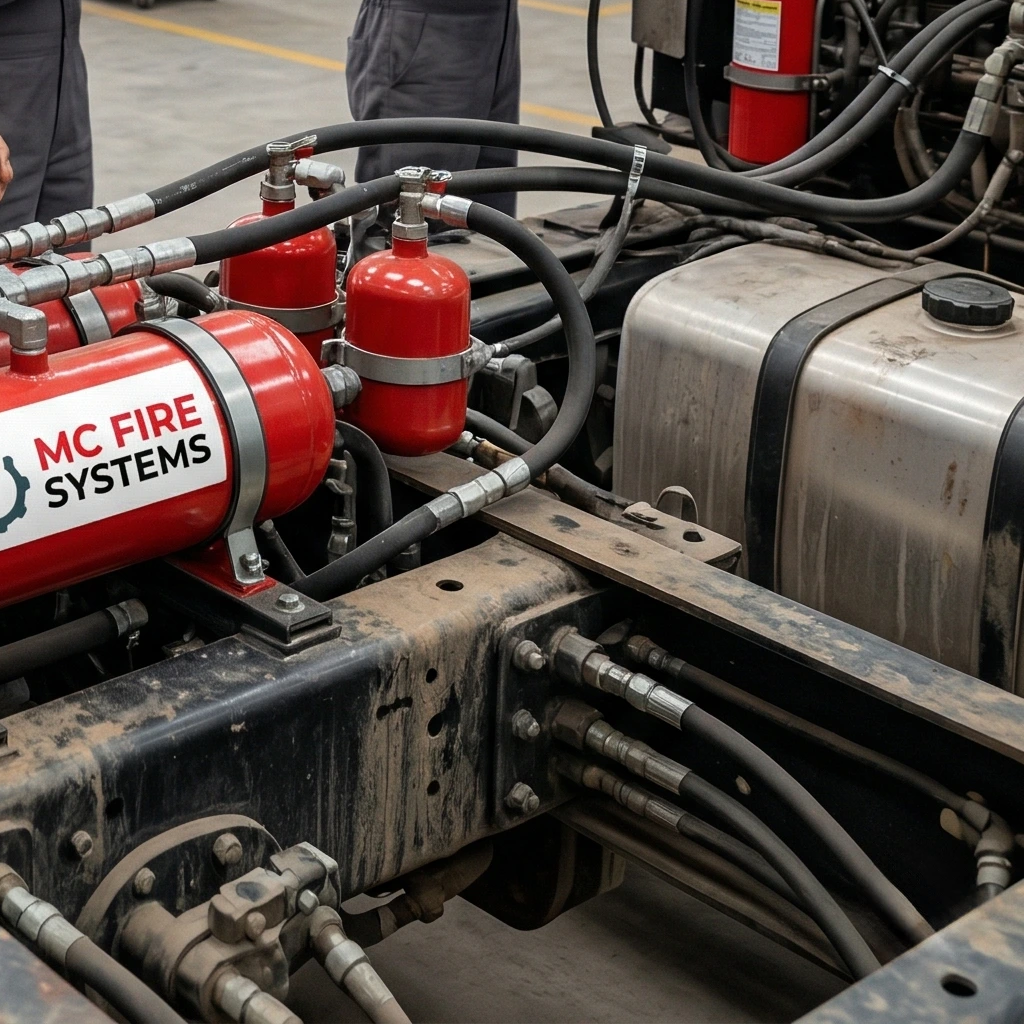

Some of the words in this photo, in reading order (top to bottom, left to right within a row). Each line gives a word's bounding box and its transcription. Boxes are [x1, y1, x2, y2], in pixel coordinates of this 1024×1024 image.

[34, 423, 103, 470] MC
[110, 394, 202, 448] FIRE
[44, 433, 212, 508] SYSTEMS
